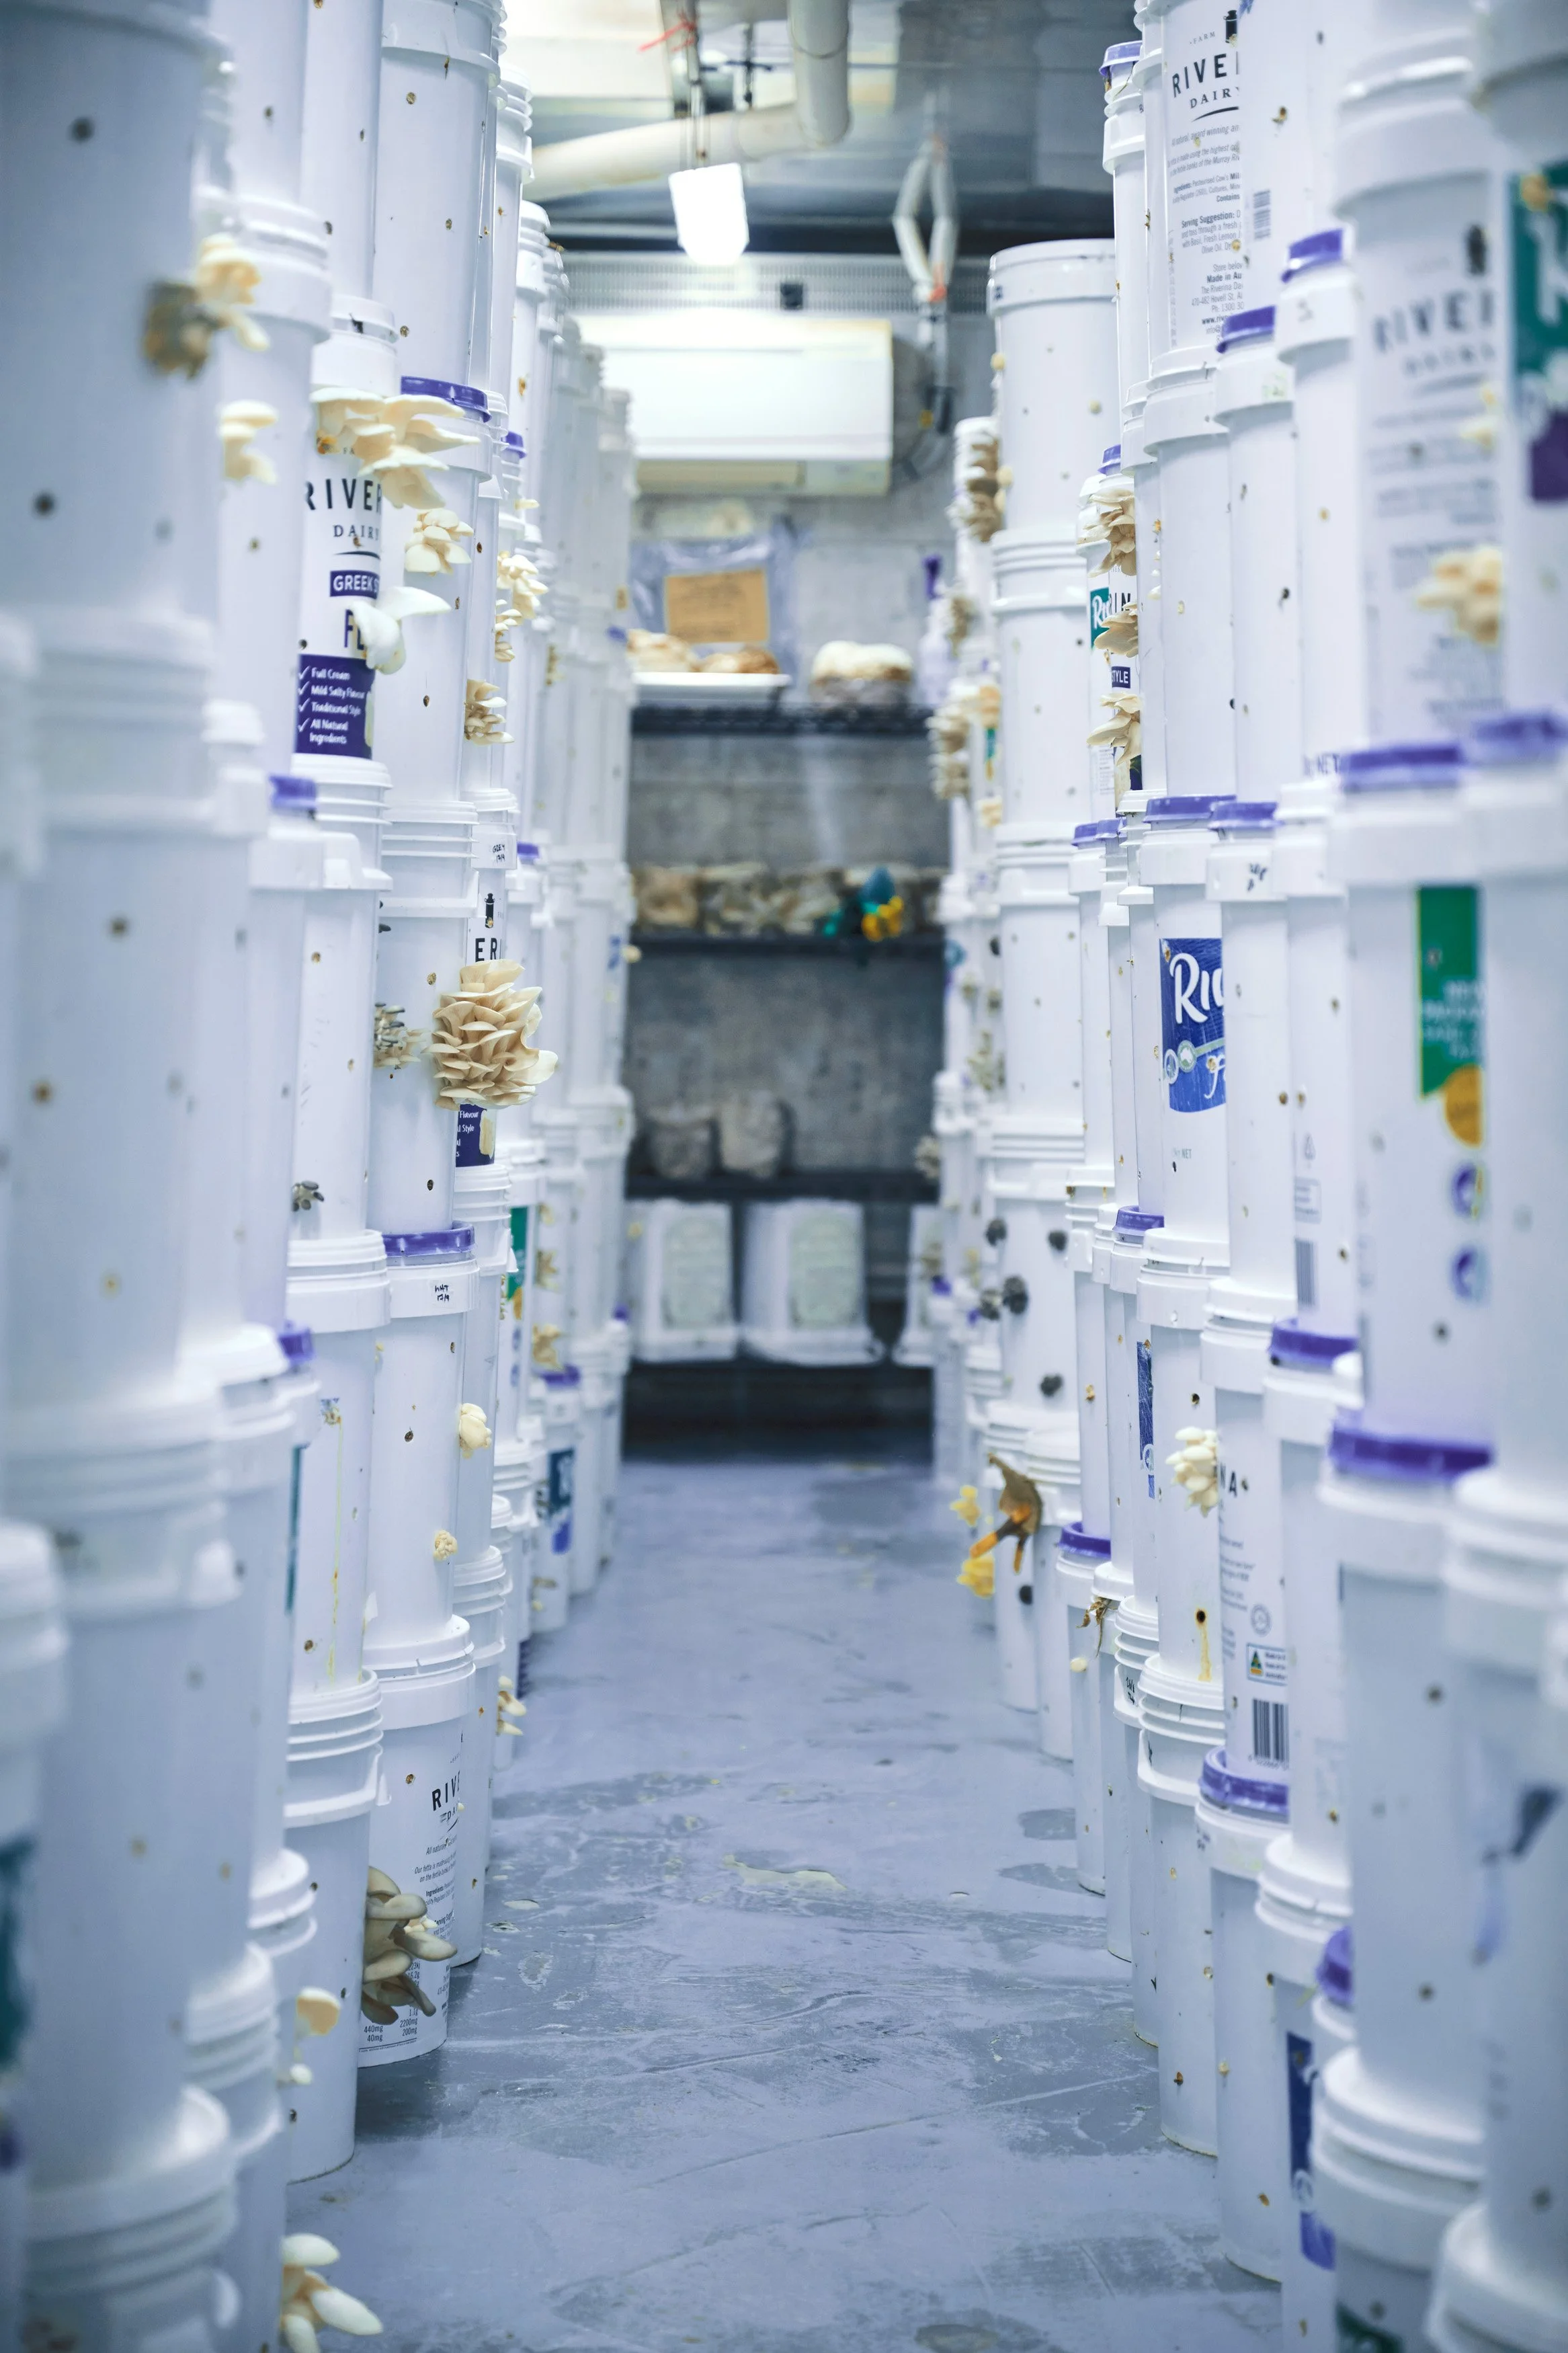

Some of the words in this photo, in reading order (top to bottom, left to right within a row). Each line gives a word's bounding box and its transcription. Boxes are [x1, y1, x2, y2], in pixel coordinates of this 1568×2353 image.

[1172, 51, 1239, 97] RIVE
[1206, 126, 1229, 136] winning
[1210, 144, 1229, 155] highest
[1212, 155, 1230, 164] Murray
[1216, 194, 1241, 202] Contains
[1182, 218, 1198, 229] Serving
[1200, 211, 1235, 224] Suggestion:
[1198, 225, 1217, 234] through
[1223, 221, 1237, 229] fresh
[1204, 235, 1217, 243] Fresh
[1219, 233, 1236, 241] Lemon
[1212, 264, 1227, 272] Store
[1206, 274, 1223, 283] Made
[1201, 286, 1210, 294] The
[1210, 283, 1232, 293] Riverina
[1210, 292, 1227, 303] Hovell
[1221, 302, 1235, 313] 1300
[333, 574, 373, 592] GREEK
[311, 684, 328, 695] Mild
[311, 701, 348, 714] Traditional
[310, 719, 321, 729] All
[322, 719, 349, 731] Natural
[309, 732, 347, 746] Ingredients
[460, 1110, 479, 1119] Flavour
[462, 1124, 474, 1134] Style
[1182, 1148, 1192, 1159] NET
[414, 1866, 422, 1874] Our
[423, 1863, 432, 1872] fetta
[364, 2025, 384, 2034] 440mg
[399, 2018, 418, 2028] 2200mg
[367, 2034, 383, 2042] 40mg
[402, 2027, 417, 2037] 200mg
